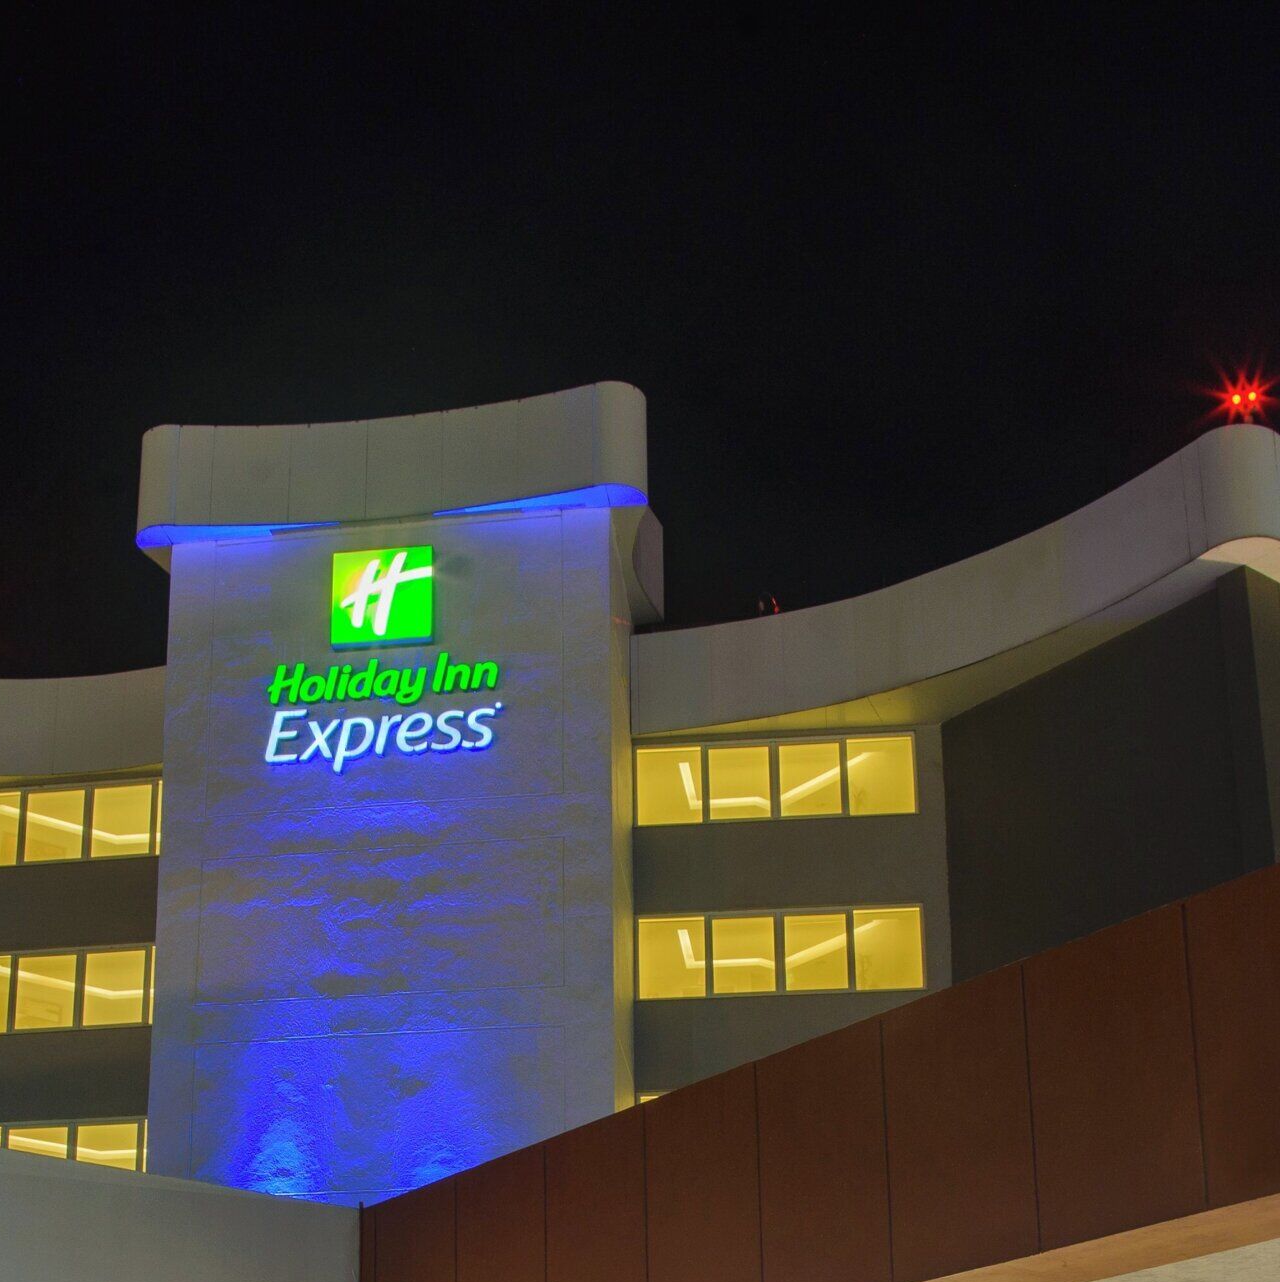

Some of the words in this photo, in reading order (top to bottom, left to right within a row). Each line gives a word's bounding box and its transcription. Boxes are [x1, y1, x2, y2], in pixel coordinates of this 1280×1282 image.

[267, 658, 427, 705] Holiday
[432, 652, 499, 693] Inn
[265, 707, 496, 774] Express
